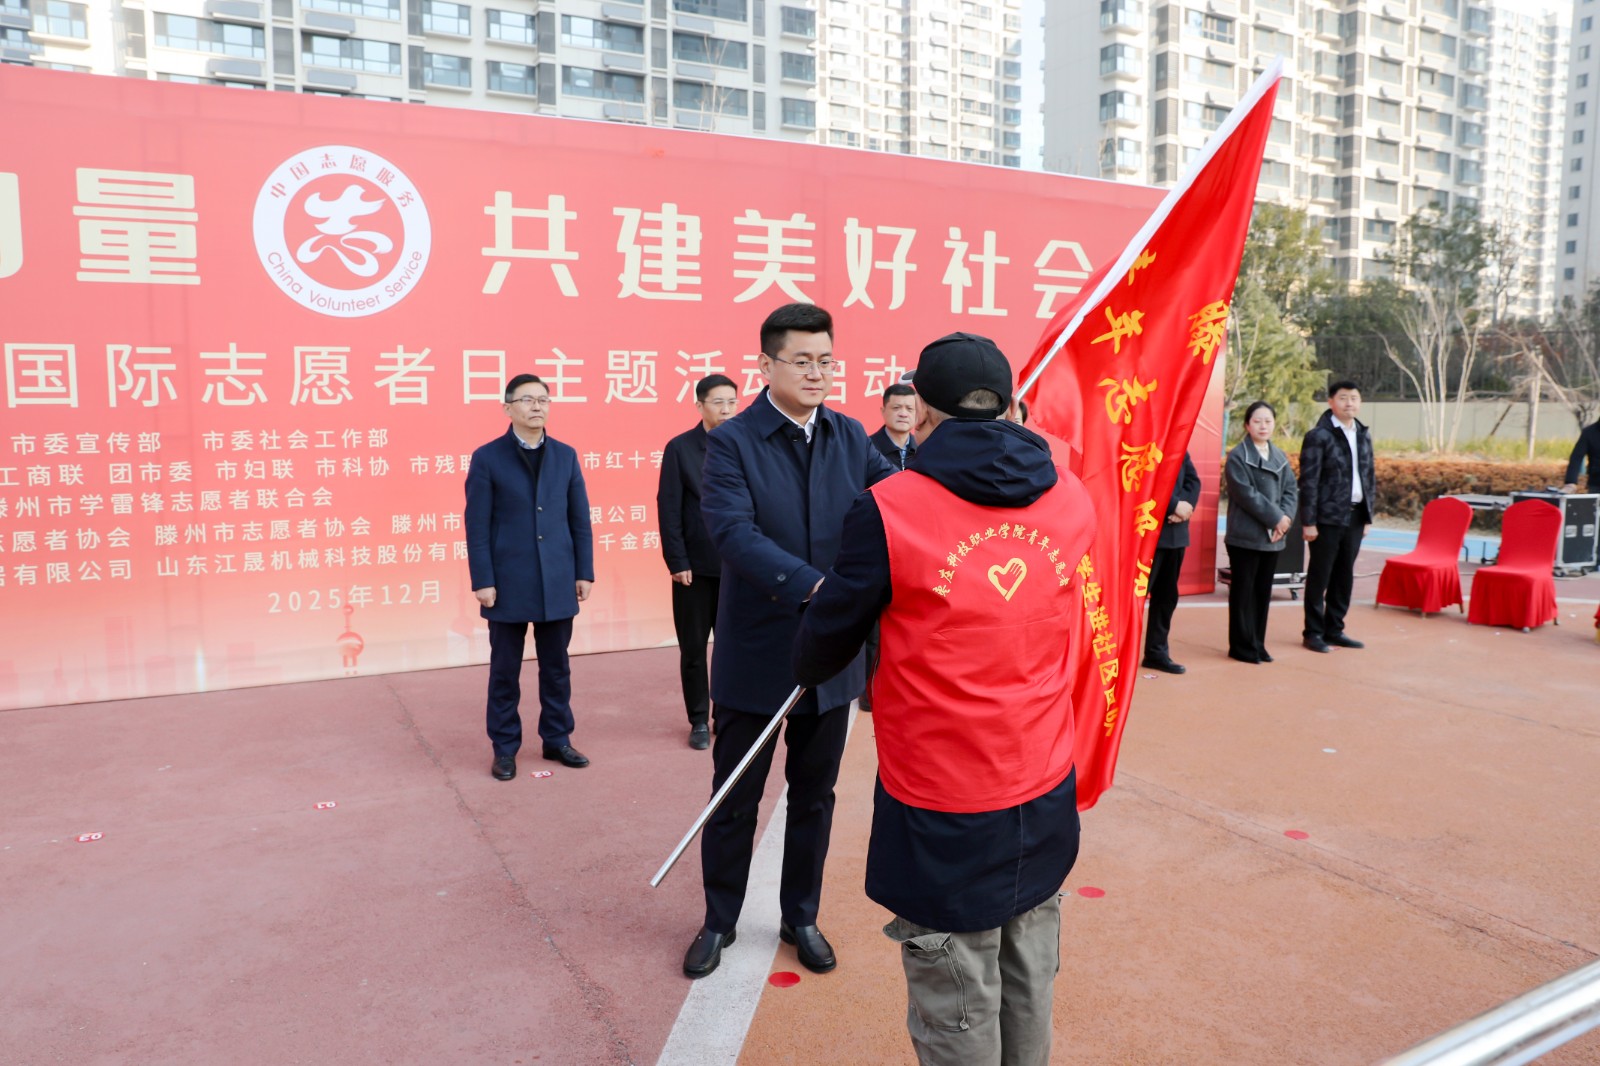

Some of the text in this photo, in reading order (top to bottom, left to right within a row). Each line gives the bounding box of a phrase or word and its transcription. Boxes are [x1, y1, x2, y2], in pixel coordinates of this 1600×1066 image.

[270, 153, 414, 207] 中国志愿服务
[480, 190, 1094, 318] 共建美好社会
[267, 251, 422, 312] China Volunteer Service
[10, 428, 389, 456] 市委宣传部 市委社会工作部
[109, 461, 193, 484] 团市委
[215, 459, 294, 481] 市妇联
[315, 456, 390, 478] 市科协
[583, 450, 664, 470] 市红十字
[0, 526, 131, 553] 愿者协会
[155, 516, 371, 546] 滕州市志愿者协会
[391, 512, 461, 534] 滕州市
[0, 559, 132, 587] 有限公司
[268, 580, 440, 613] 2025年12月
